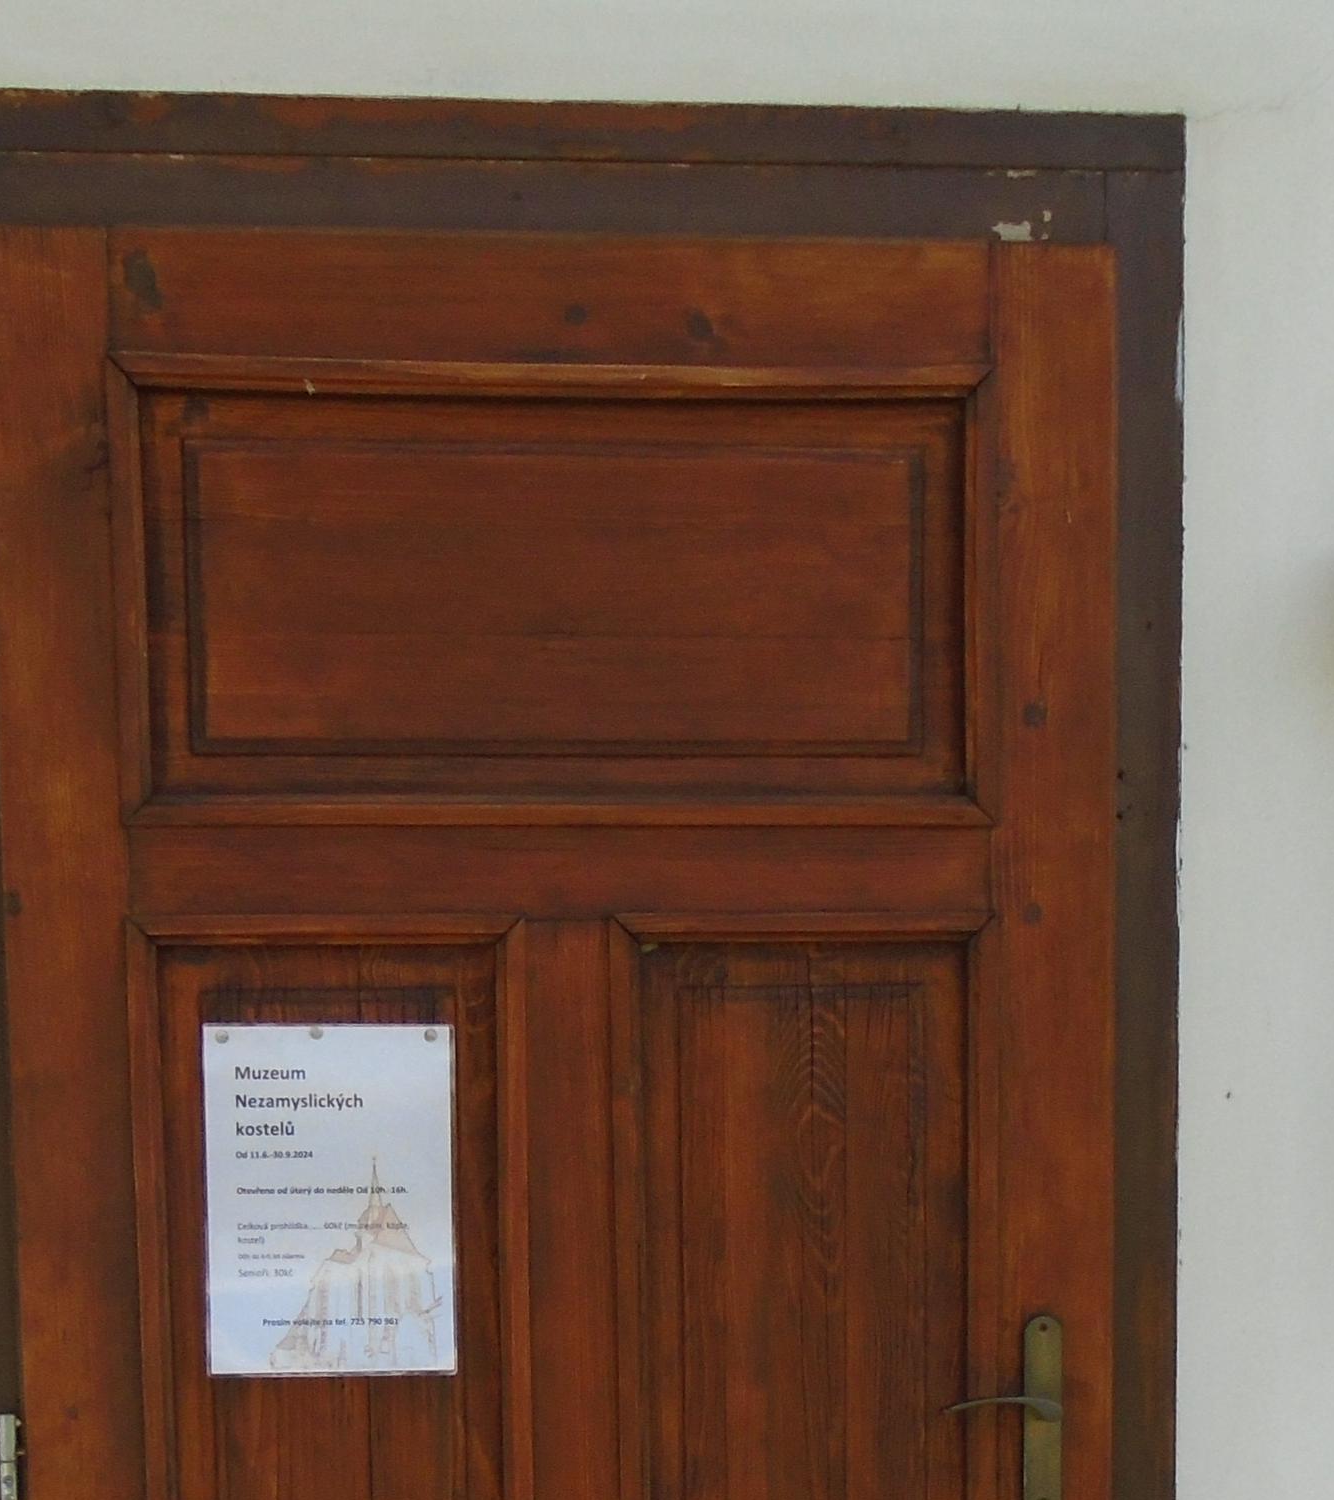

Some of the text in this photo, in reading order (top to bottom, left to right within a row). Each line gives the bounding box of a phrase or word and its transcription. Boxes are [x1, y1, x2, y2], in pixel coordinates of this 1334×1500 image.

[234, 1066, 307, 1080] Muzeum
[234, 1093, 364, 1111] Nezamyslických
[235, 1120, 295, 1137] kostelů
[235, 1151, 248, 1159] Od
[277, 1187, 288, 1195] od
[262, 1318, 290, 1326] Prosím
